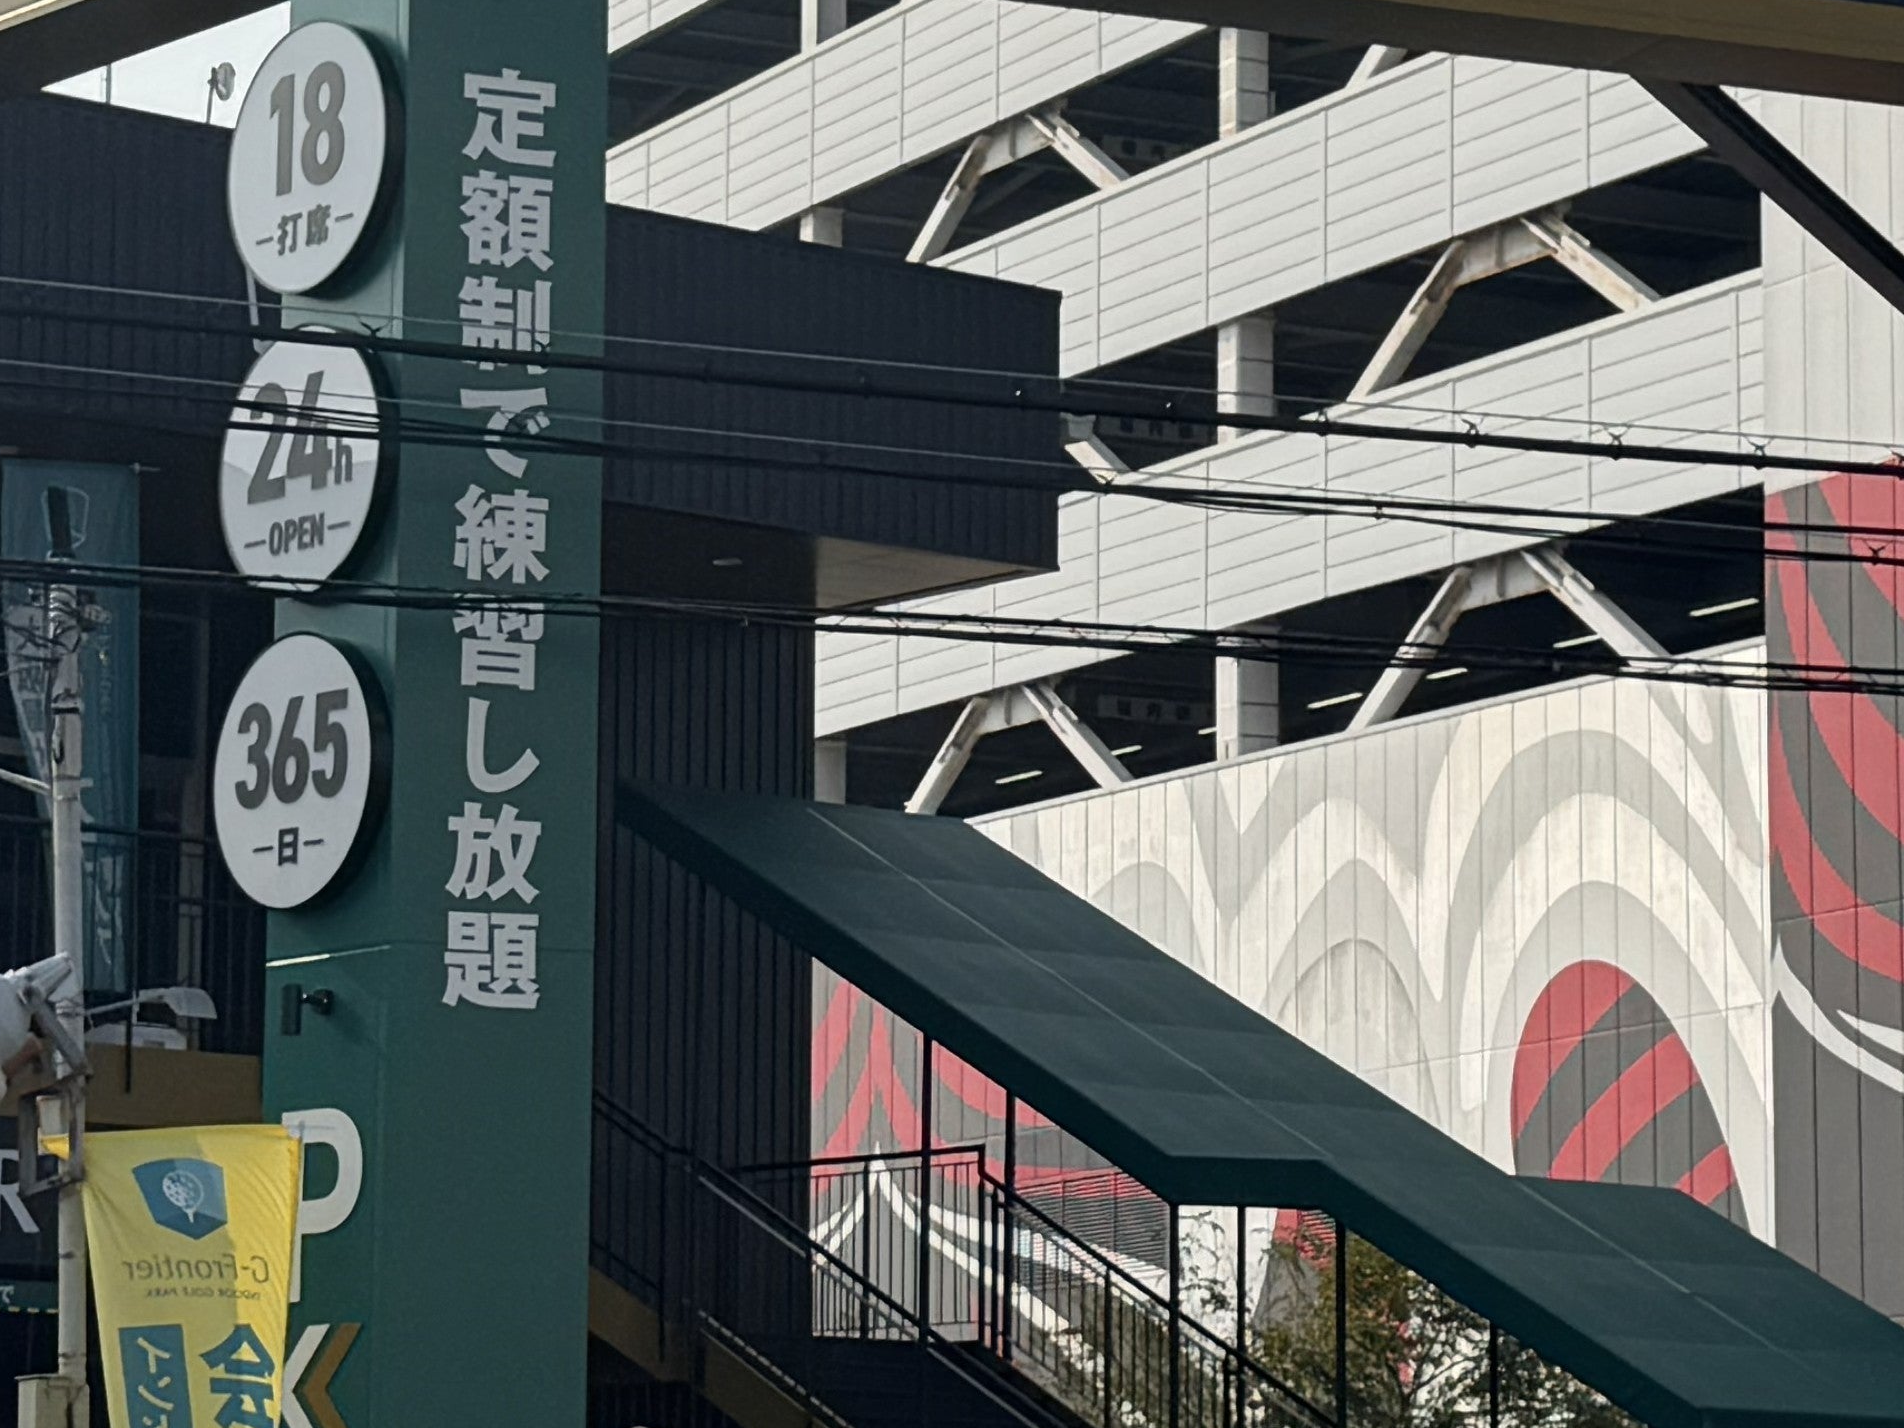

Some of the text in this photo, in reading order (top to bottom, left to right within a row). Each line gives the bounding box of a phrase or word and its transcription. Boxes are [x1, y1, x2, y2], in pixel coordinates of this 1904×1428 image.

[269, 60, 346, 197] 18
[248, 371, 353, 505] 24h
[269, 513, 325, 555] OPEN
[442, 68, 556, 1010] 定額制で練習し放題
[235, 687, 349, 810] 365
[282, 1108, 363, 1304] P
